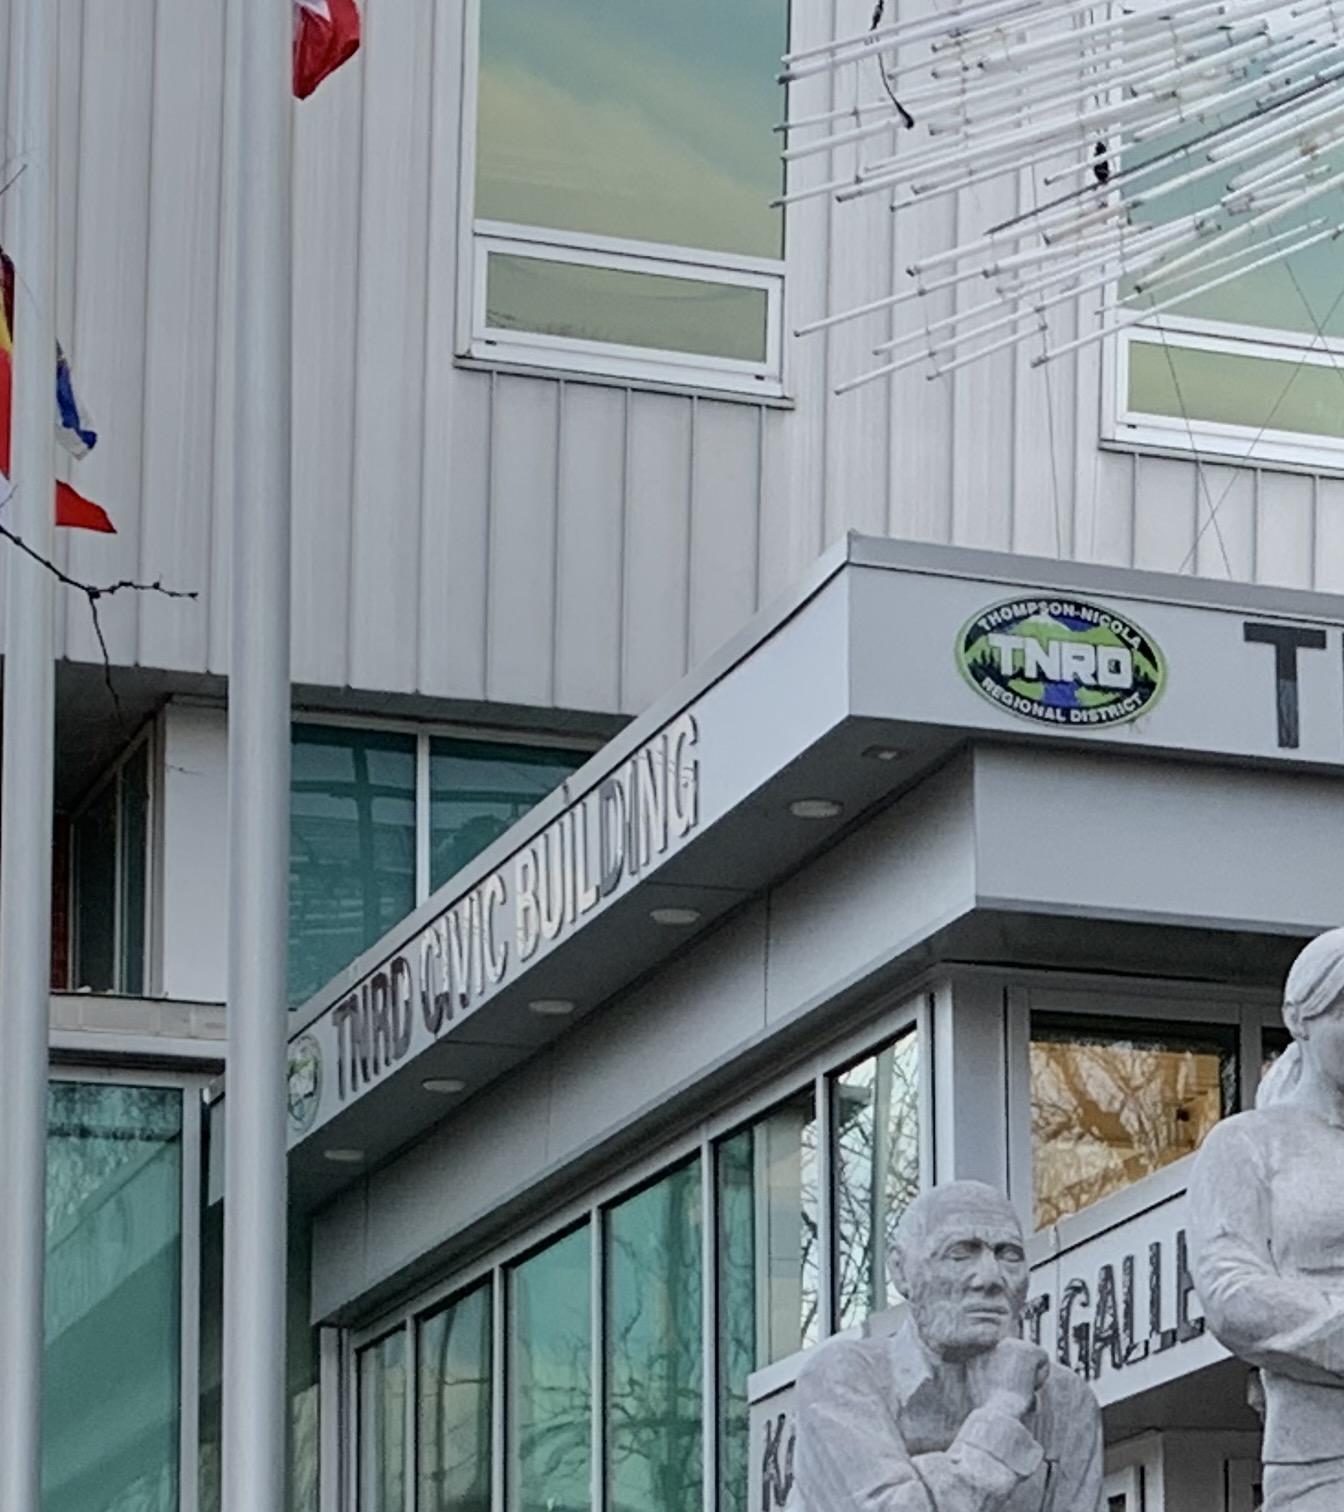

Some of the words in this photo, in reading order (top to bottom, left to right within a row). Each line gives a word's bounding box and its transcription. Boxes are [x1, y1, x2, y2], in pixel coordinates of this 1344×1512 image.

[978, 601, 1142, 649] THOMPSON-NICOLA
[988, 633, 1133, 689] TNRD
[982, 677, 1066, 722] REGIONAL
[1070, 692, 1143, 723] DISTRICT
[332, 955, 412, 1101] TNRD
[420, 873, 508, 1036] CIVIC
[516, 713, 699, 961] BUILDING
